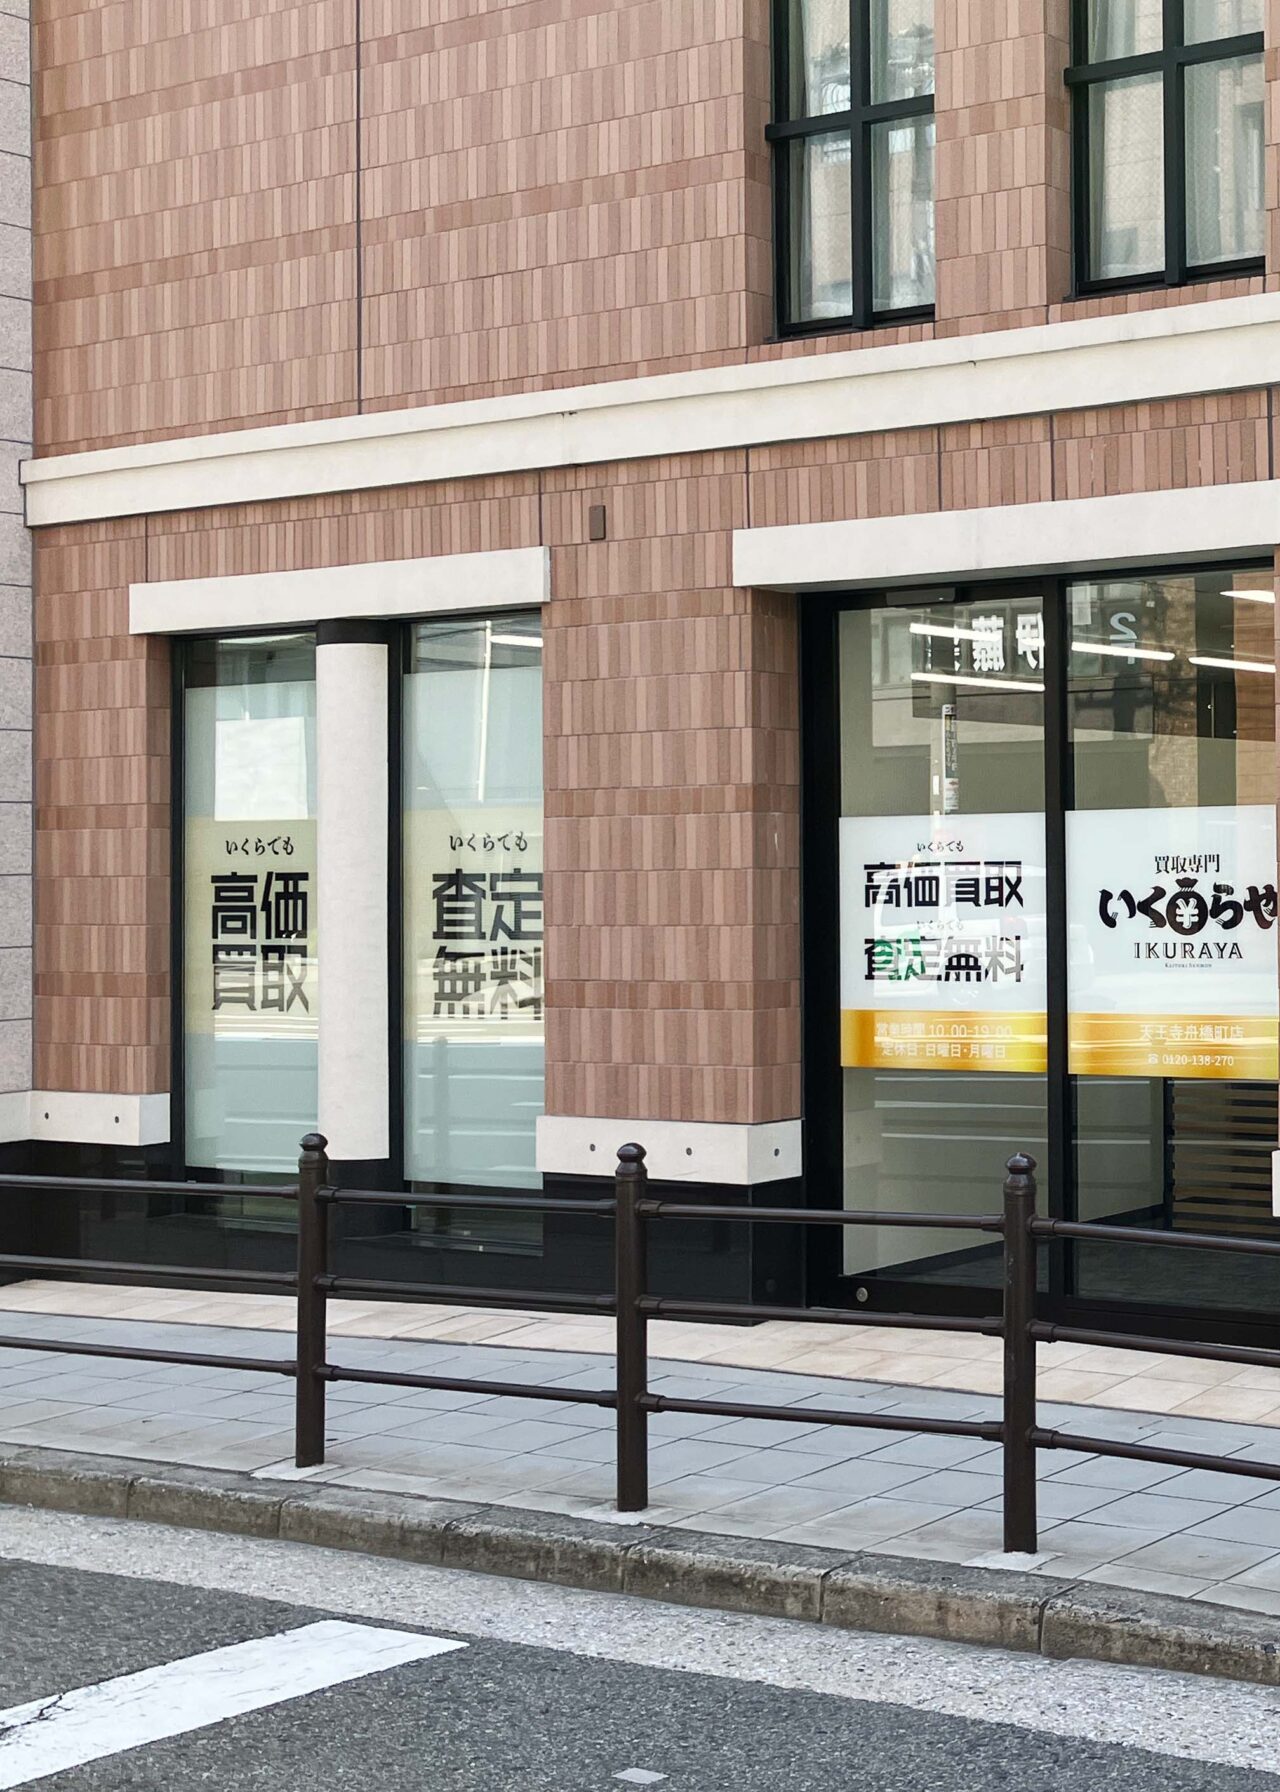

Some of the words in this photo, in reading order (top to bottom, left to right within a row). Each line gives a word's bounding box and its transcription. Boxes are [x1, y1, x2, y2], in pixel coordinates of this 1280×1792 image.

[225, 836, 294, 856] いくらでも
[449, 831, 528, 852] いくらでも
[1154, 853, 1221, 875] 買取専門
[211, 871, 310, 940] 高価
[432, 868, 544, 941] 査定
[863, 860, 1024, 908] 高価買取
[863, 935, 1024, 983] 査定無料
[1133, 942, 1244, 959] IKURAYA
[211, 943, 310, 1014] 買取
[432, 946, 544, 1020] 無料
[1162, 1054, 1235, 1067] 0120-138-270
